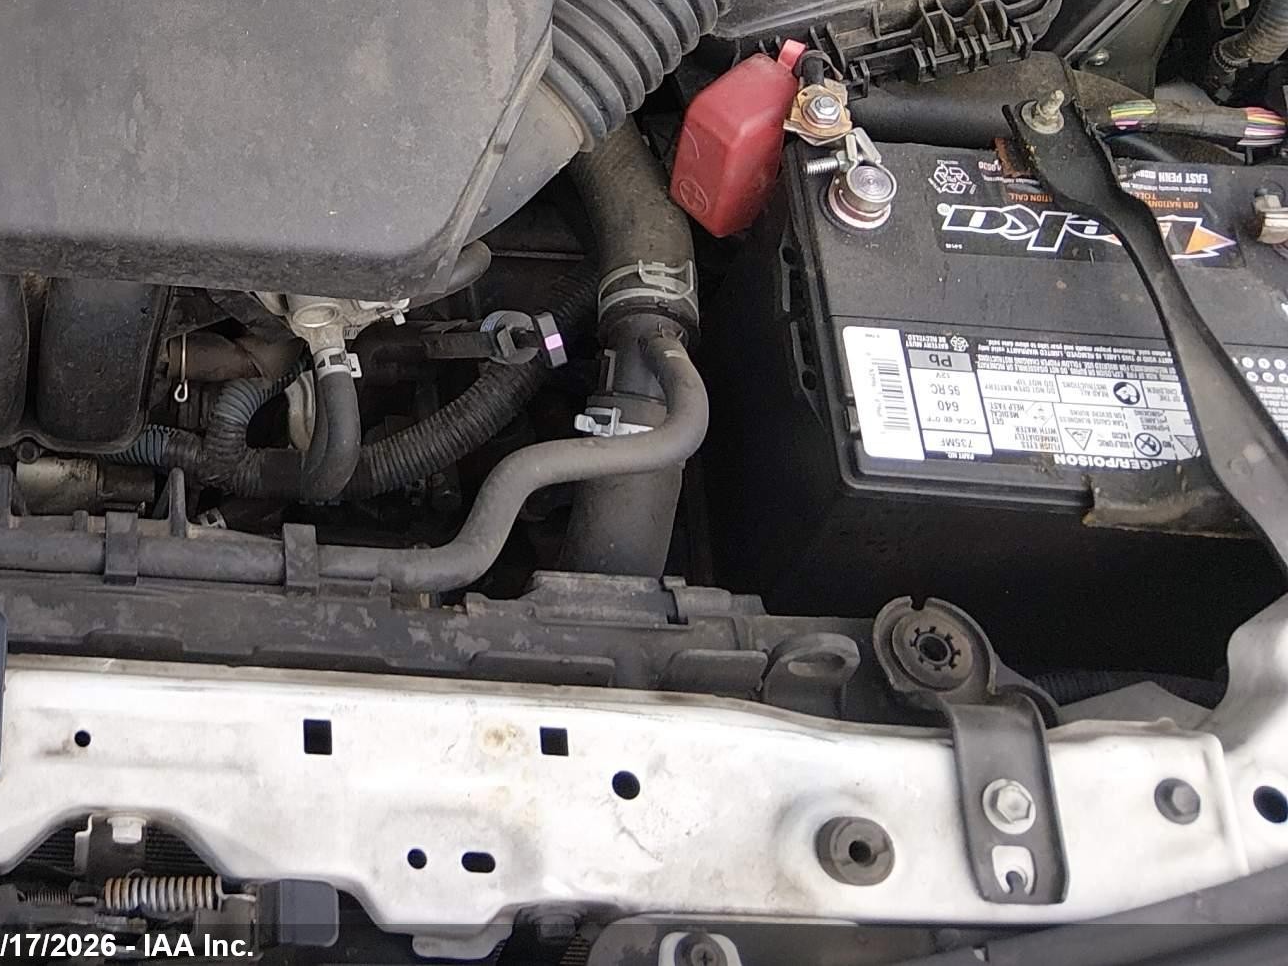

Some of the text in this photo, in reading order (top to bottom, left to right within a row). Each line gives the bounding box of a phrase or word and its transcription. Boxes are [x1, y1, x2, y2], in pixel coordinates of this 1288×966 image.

[1185, 173, 1208, 184] EAST
[1008, 193, 1029, 201] CALL
[929, 354, 952, 367] Pb
[931, 384, 945, 394] RC
[938, 401, 959, 412] 640
[1009, 403, 1024, 411] HELP
[990, 410, 1019, 418] MEDICAL
[939, 438, 973, 448] 735MF
[1015, 434, 1059, 442] IMMEDIATELY
[1053, 454, 1167, 470] NGER/POISON
